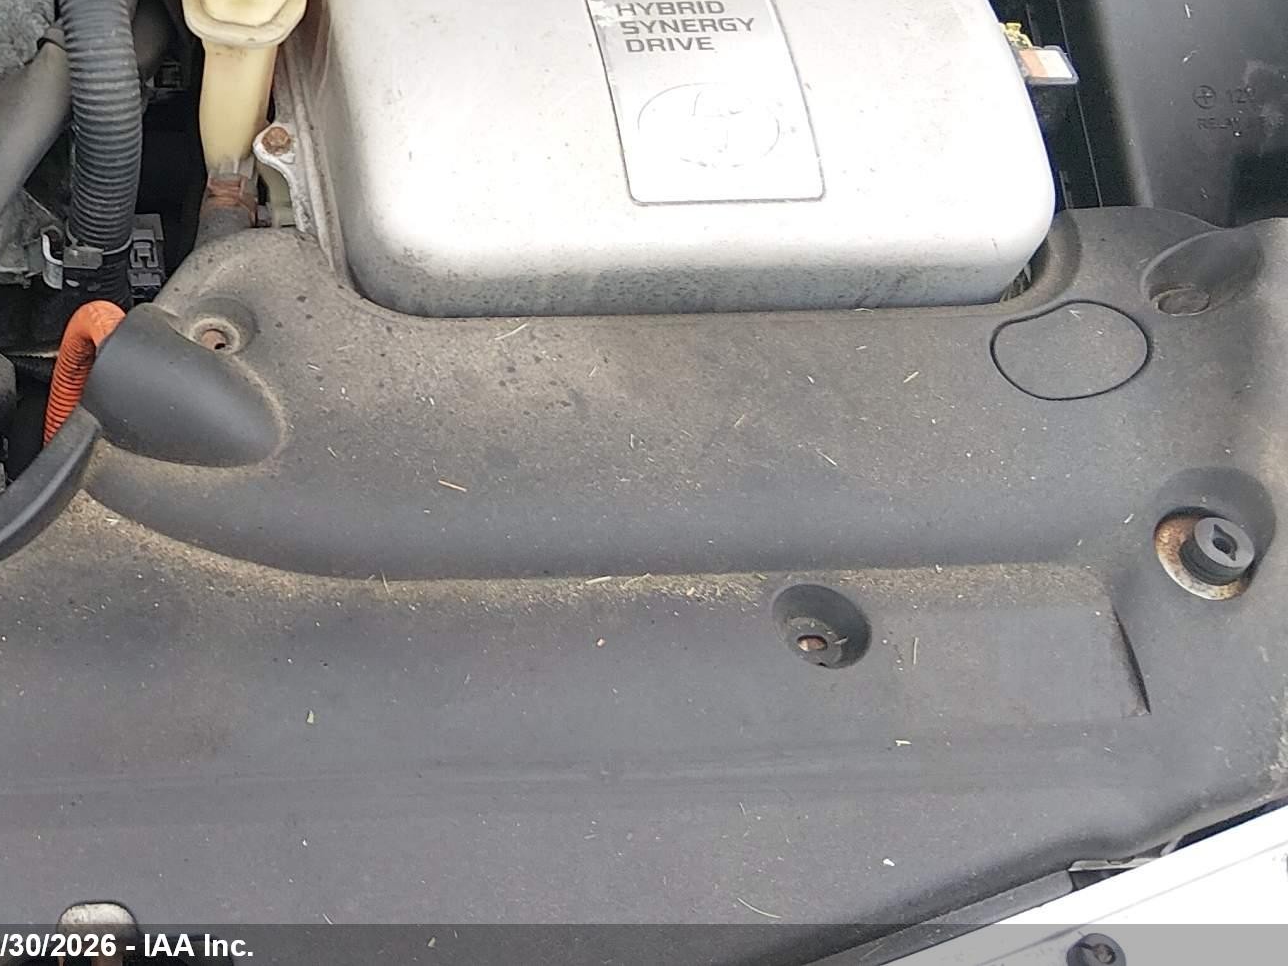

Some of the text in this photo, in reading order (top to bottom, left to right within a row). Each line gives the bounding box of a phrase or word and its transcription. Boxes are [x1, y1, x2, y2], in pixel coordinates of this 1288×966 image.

[616, 0, 725, 16] HYBRID
[620, 18, 755, 35] SYNERGY
[626, 37, 714, 52] DRIVE
